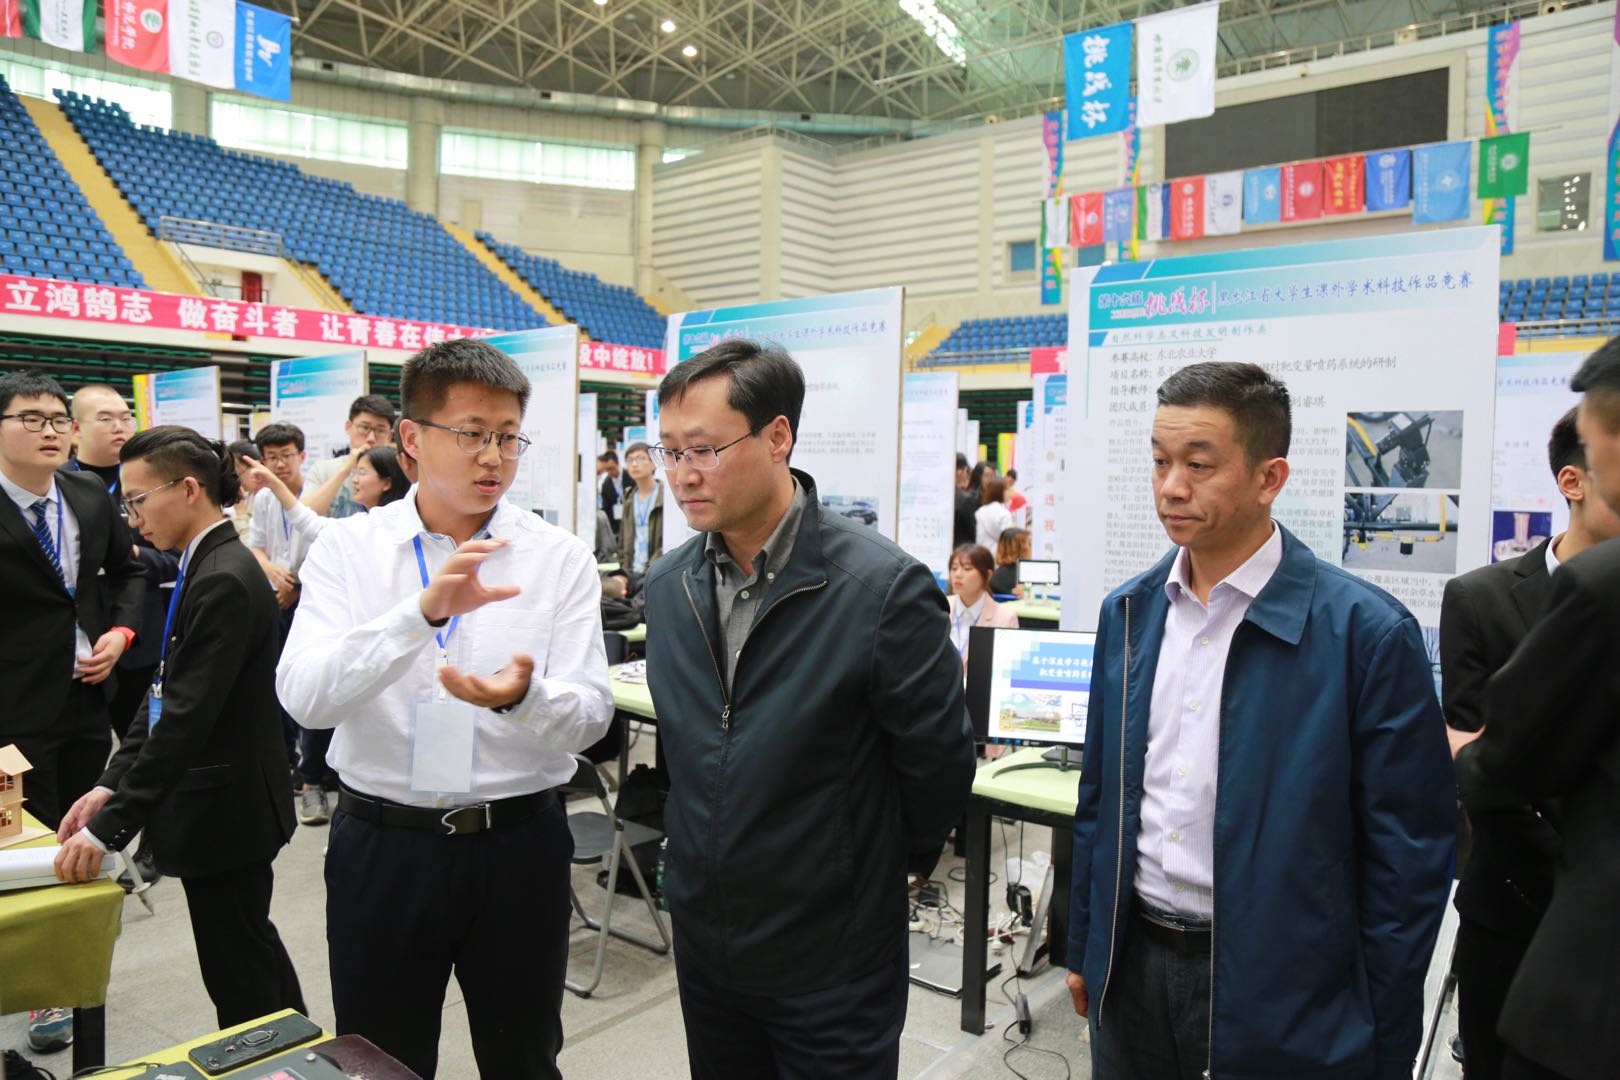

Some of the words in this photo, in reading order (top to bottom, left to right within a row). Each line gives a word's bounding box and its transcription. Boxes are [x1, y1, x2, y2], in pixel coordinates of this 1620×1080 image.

[1081, 34, 1112, 129] 挑战杯
[5, 282, 153, 323] 立鸿鹄志
[177, 297, 299, 338] 做奋斗者
[319, 315, 487, 350] 让青春在伟
[1098, 290, 1143, 309] 第十六届
[1145, 285, 1210, 319] 挑战杯
[1219, 269, 1472, 304] 黑龙江省大学生课外学术科技作品竞赛
[1111, 323, 1267, 343] 自然科学类及科技发明制作类
[1157, 346, 1217, 361] 东北农业大学
